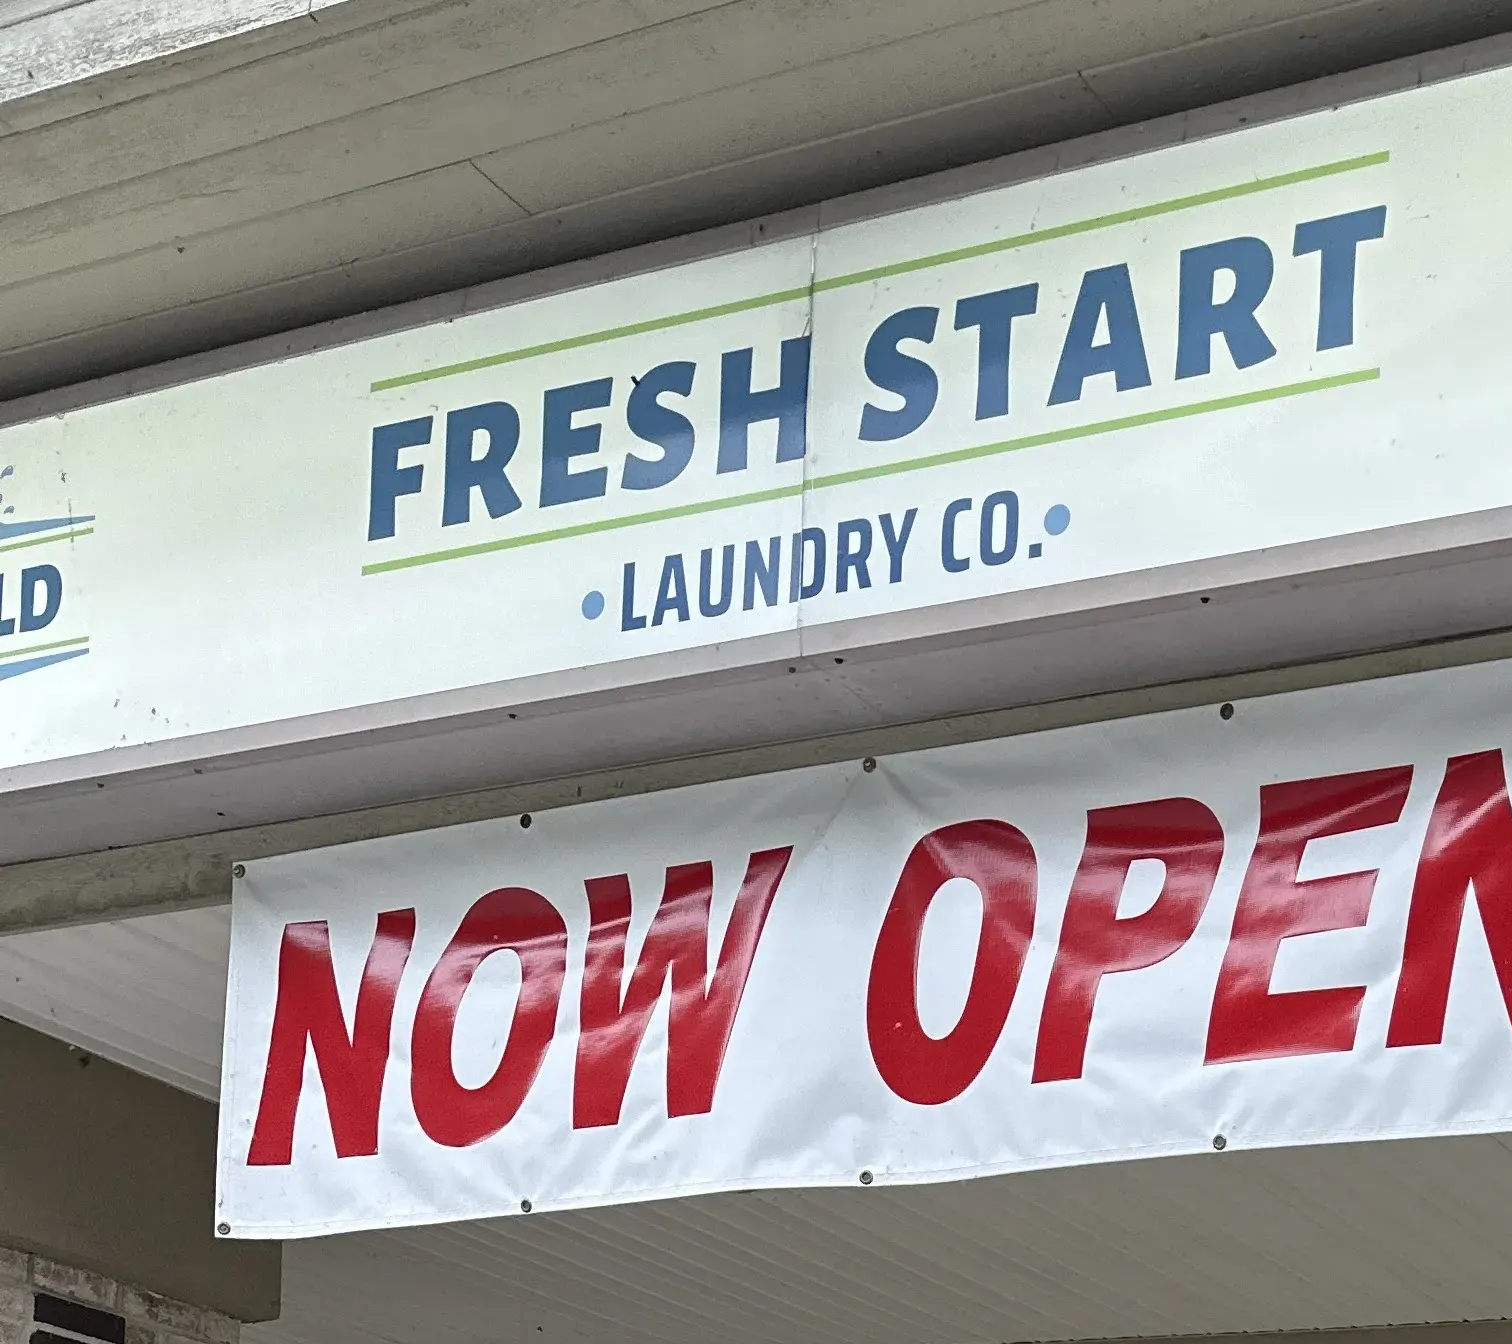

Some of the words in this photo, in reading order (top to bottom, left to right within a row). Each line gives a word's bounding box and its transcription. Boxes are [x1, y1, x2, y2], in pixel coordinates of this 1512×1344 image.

[368, 336, 811, 541] FRESH
[859, 207, 1387, 442] START
[620, 508, 917, 631] LAUNDRY
[941, 490, 1042, 573] CO.
[246, 846, 793, 1166] NOW
